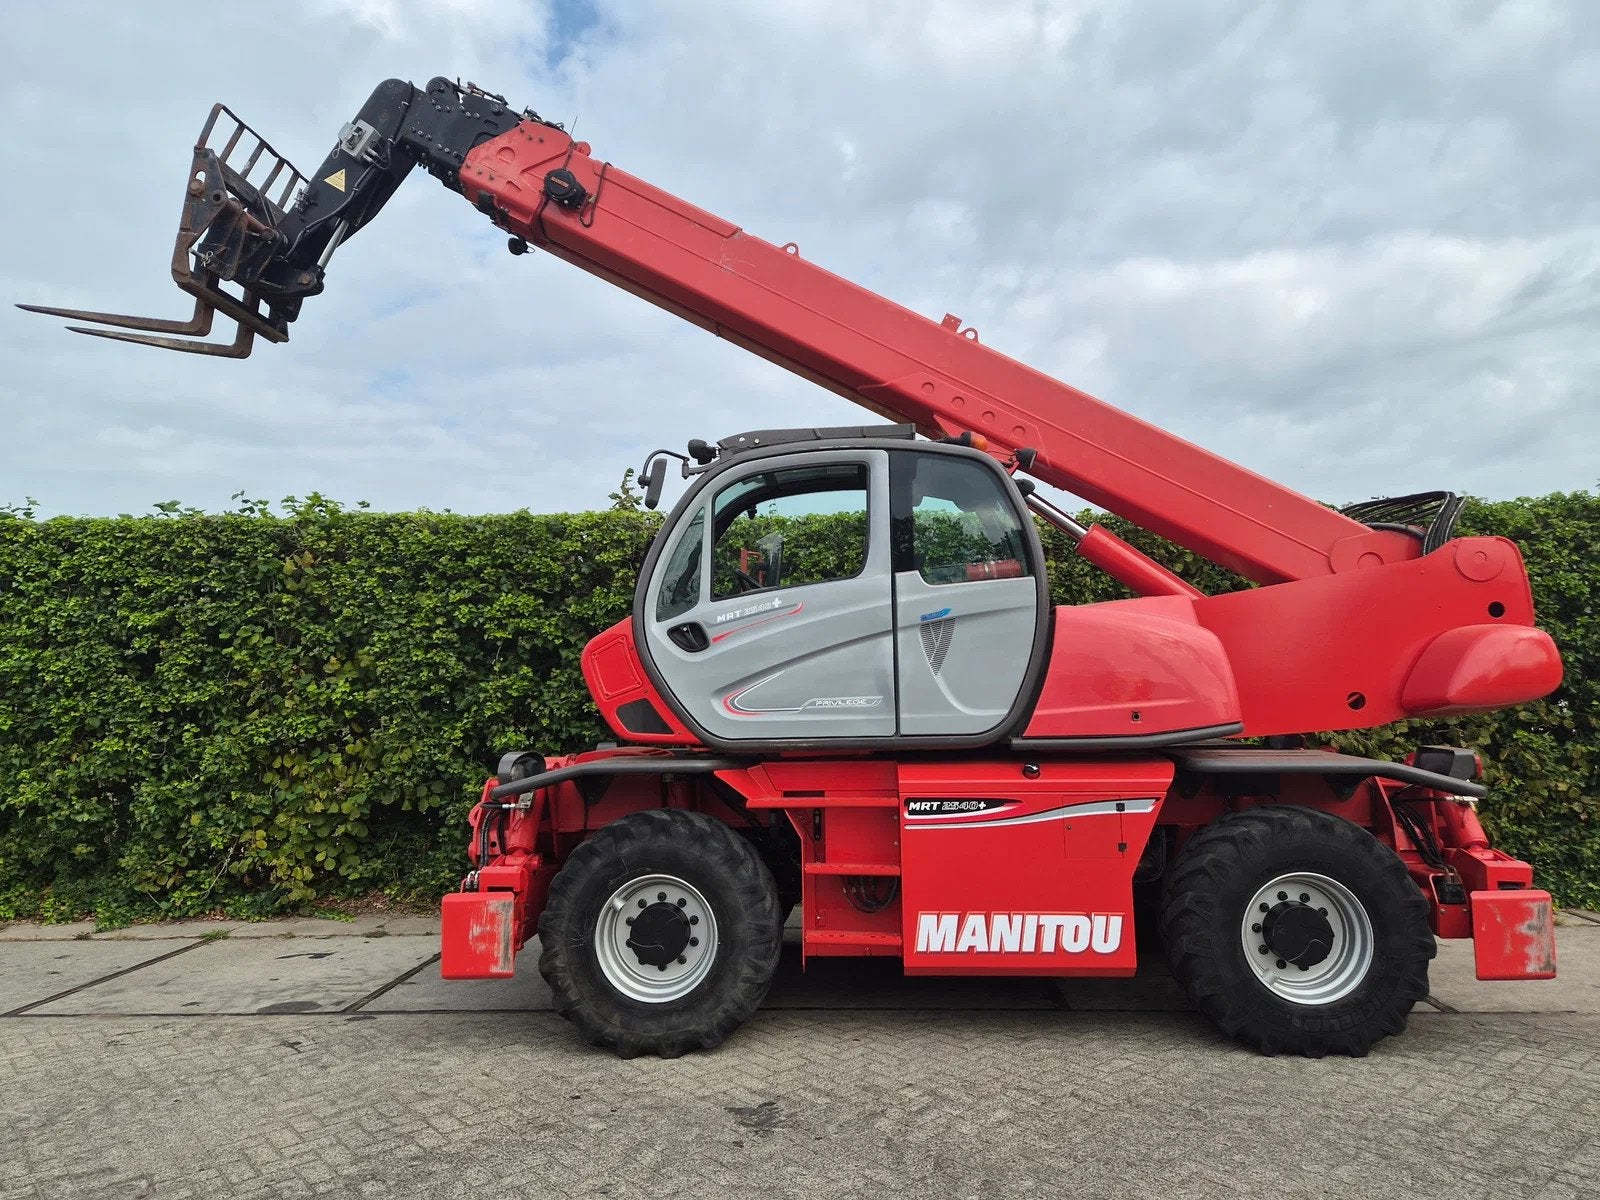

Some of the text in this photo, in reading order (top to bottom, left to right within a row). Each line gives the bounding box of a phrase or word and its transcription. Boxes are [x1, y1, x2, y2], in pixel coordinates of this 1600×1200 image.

[717, 610, 741, 623] MRT
[815, 698, 867, 706] PRIVILEGE
[908, 801, 987, 811] MRT 2540+
[915, 911, 1124, 954] MANITOU
